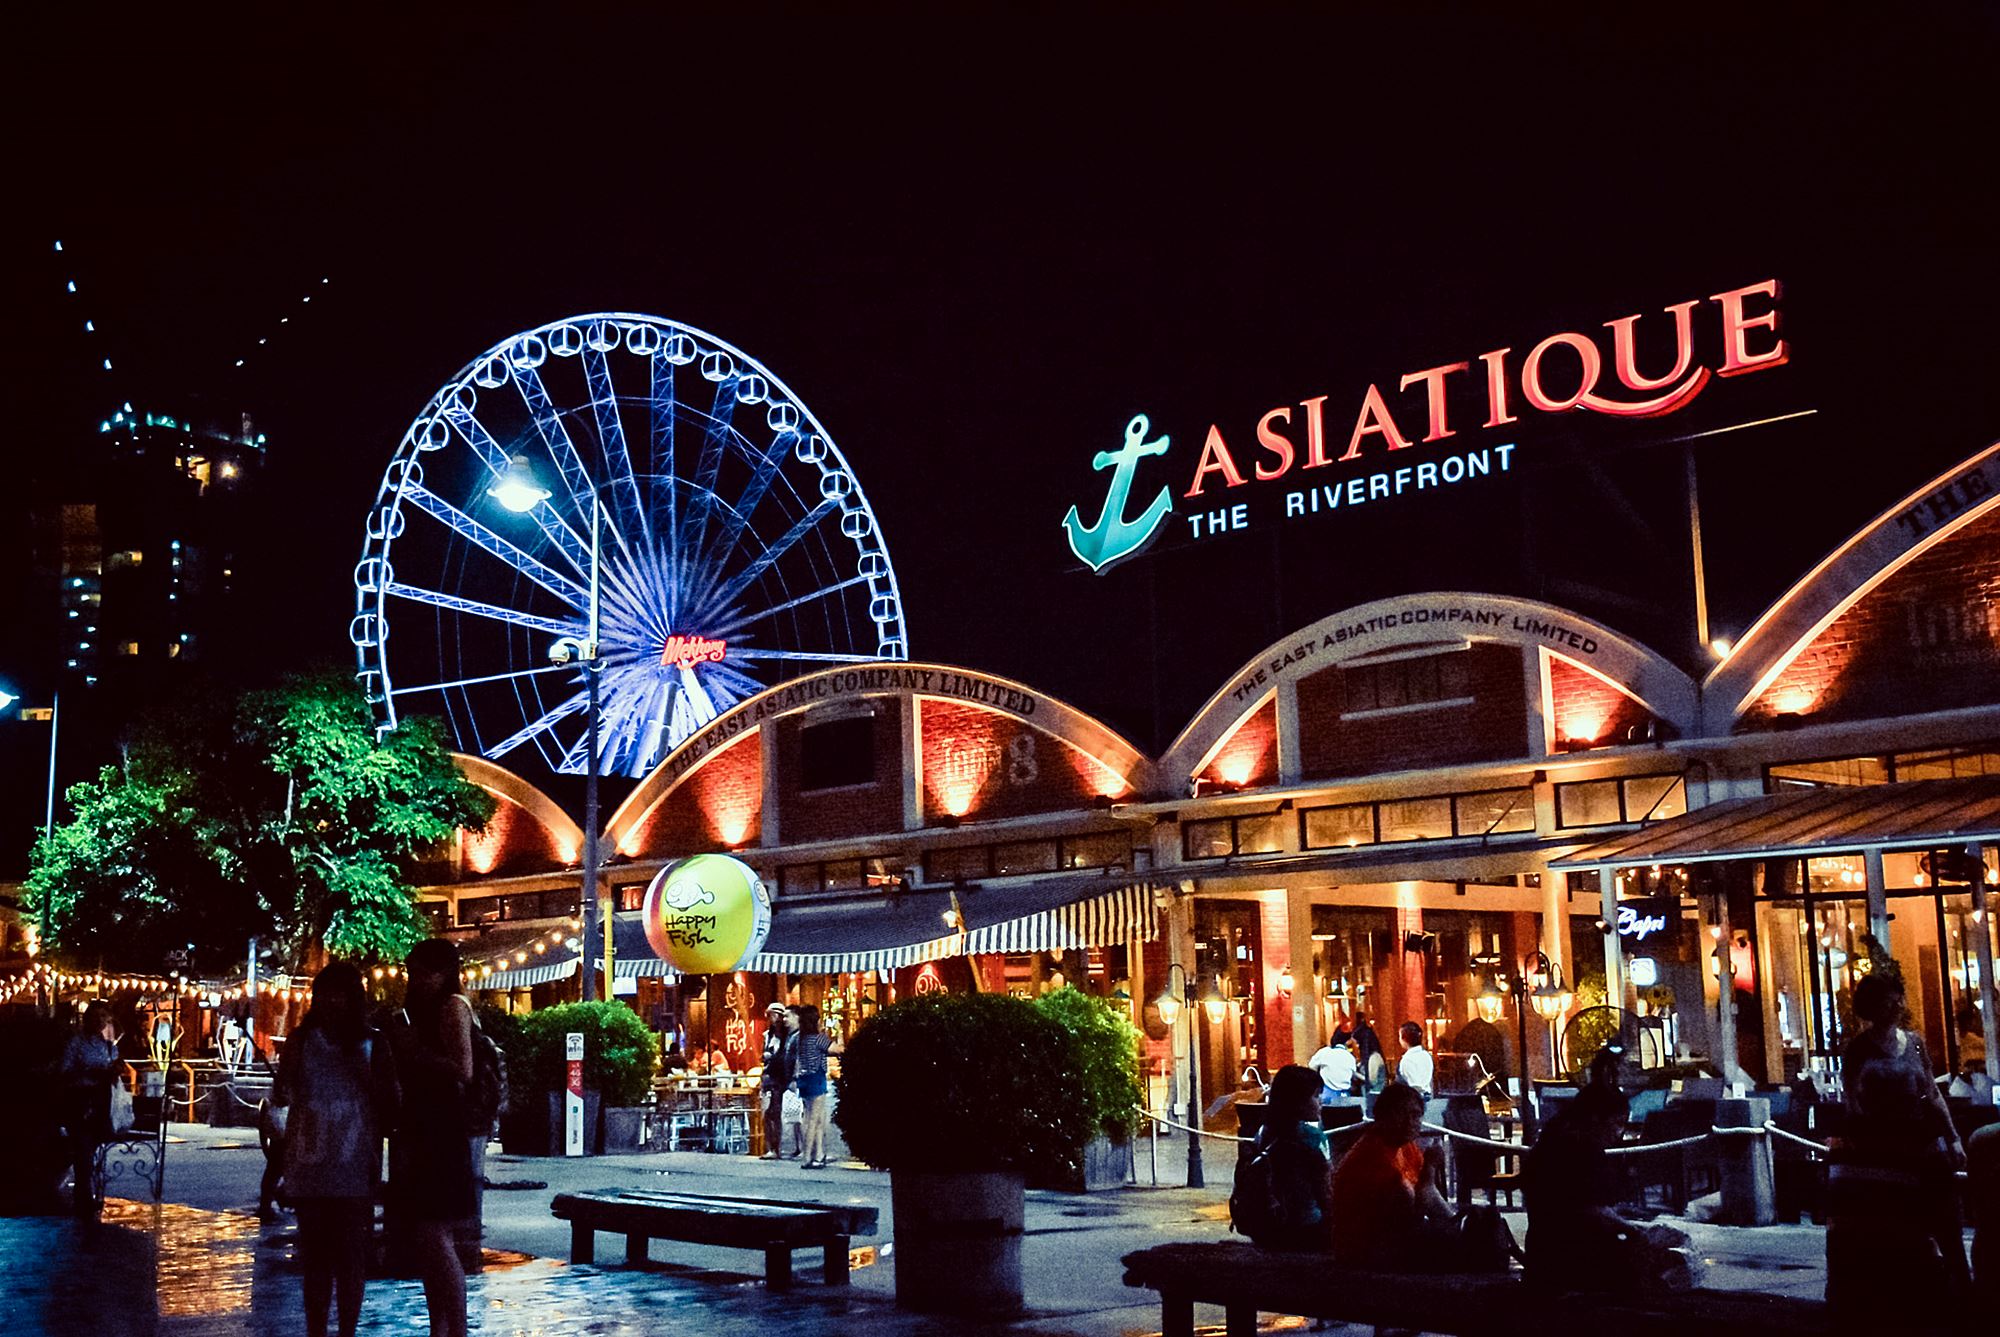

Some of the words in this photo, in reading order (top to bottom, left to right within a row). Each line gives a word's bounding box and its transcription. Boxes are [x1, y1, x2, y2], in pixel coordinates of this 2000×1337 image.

[1184, 279, 1788, 497] ASIATIQUE
[1187, 504, 1248, 538] THE
[1286, 443, 1516, 517] RIVERFRONT
[1896, 467, 1992, 538] THE
[1233, 669, 1267, 701] THE
[1270, 640, 1316, 673] EAST
[1323, 614, 1397, 649] ASIATIC
[1401, 608, 1505, 626] COMPANY
[1513, 616, 1598, 654] LIMITED
[667, 741, 702, 775] THE
[705, 710, 749, 750] EAST
[754, 678, 828, 721] ASIATIC
[832, 669, 934, 694] COMPANY
[939, 672, 1036, 715] LIMITED
[1008, 734, 1038, 785] 8
[665, 914, 716, 929] Happy
[666, 929, 715, 949] Fish
